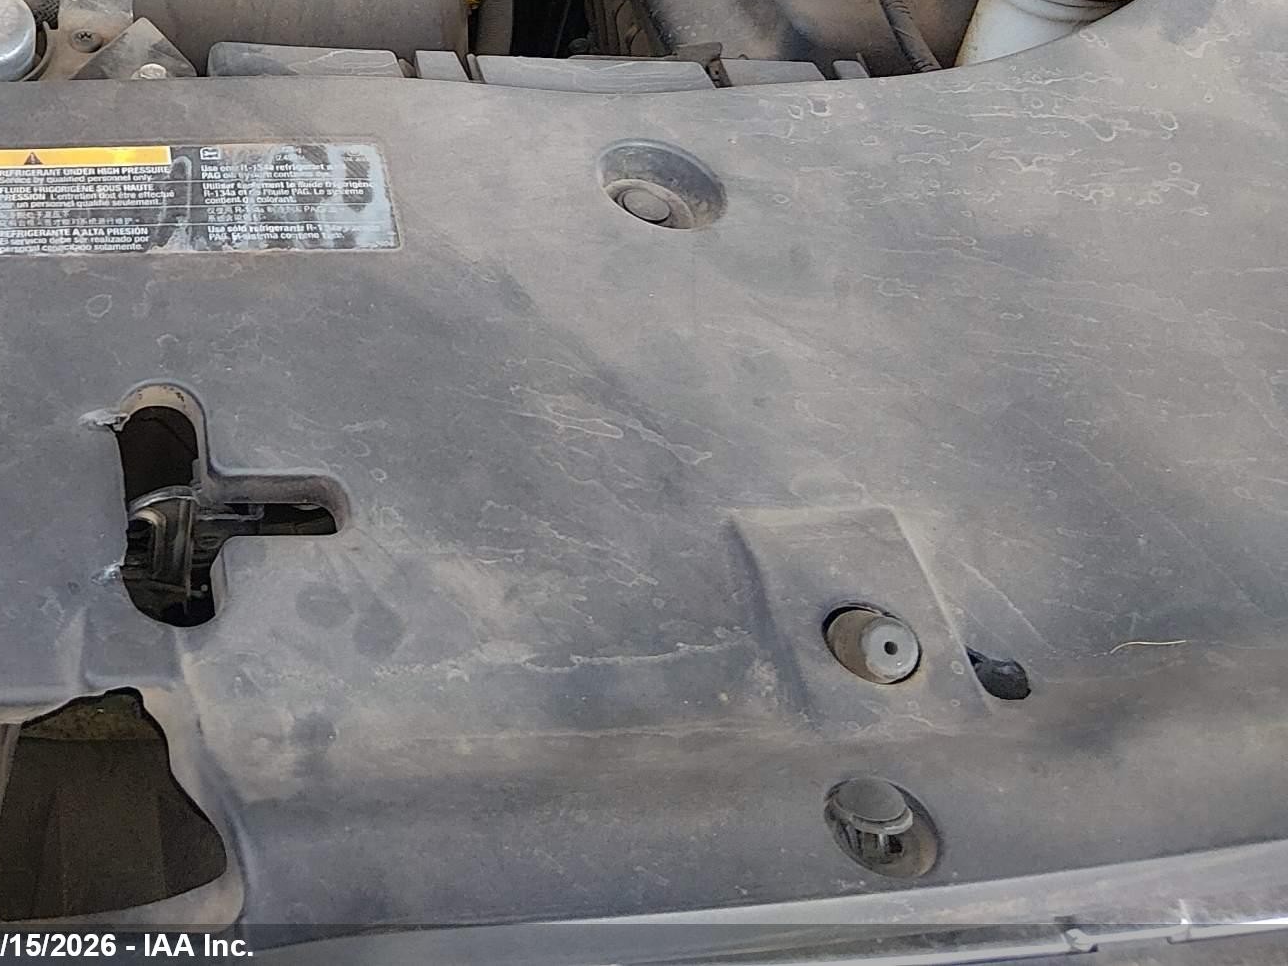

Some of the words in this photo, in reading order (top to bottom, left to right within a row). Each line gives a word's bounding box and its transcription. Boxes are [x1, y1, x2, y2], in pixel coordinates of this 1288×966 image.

[63, 168, 96, 176] UNDER
[97, 167, 120, 175] HIGH
[121, 166, 171, 174] PRESSURE
[123, 184, 154, 192] HAUTE
[0, 229, 71, 238] REFRIGERANTE
[81, 228, 105, 236] ALTA
[107, 226, 149, 235] PRESIÓN
[134, 236, 149, 244] por
